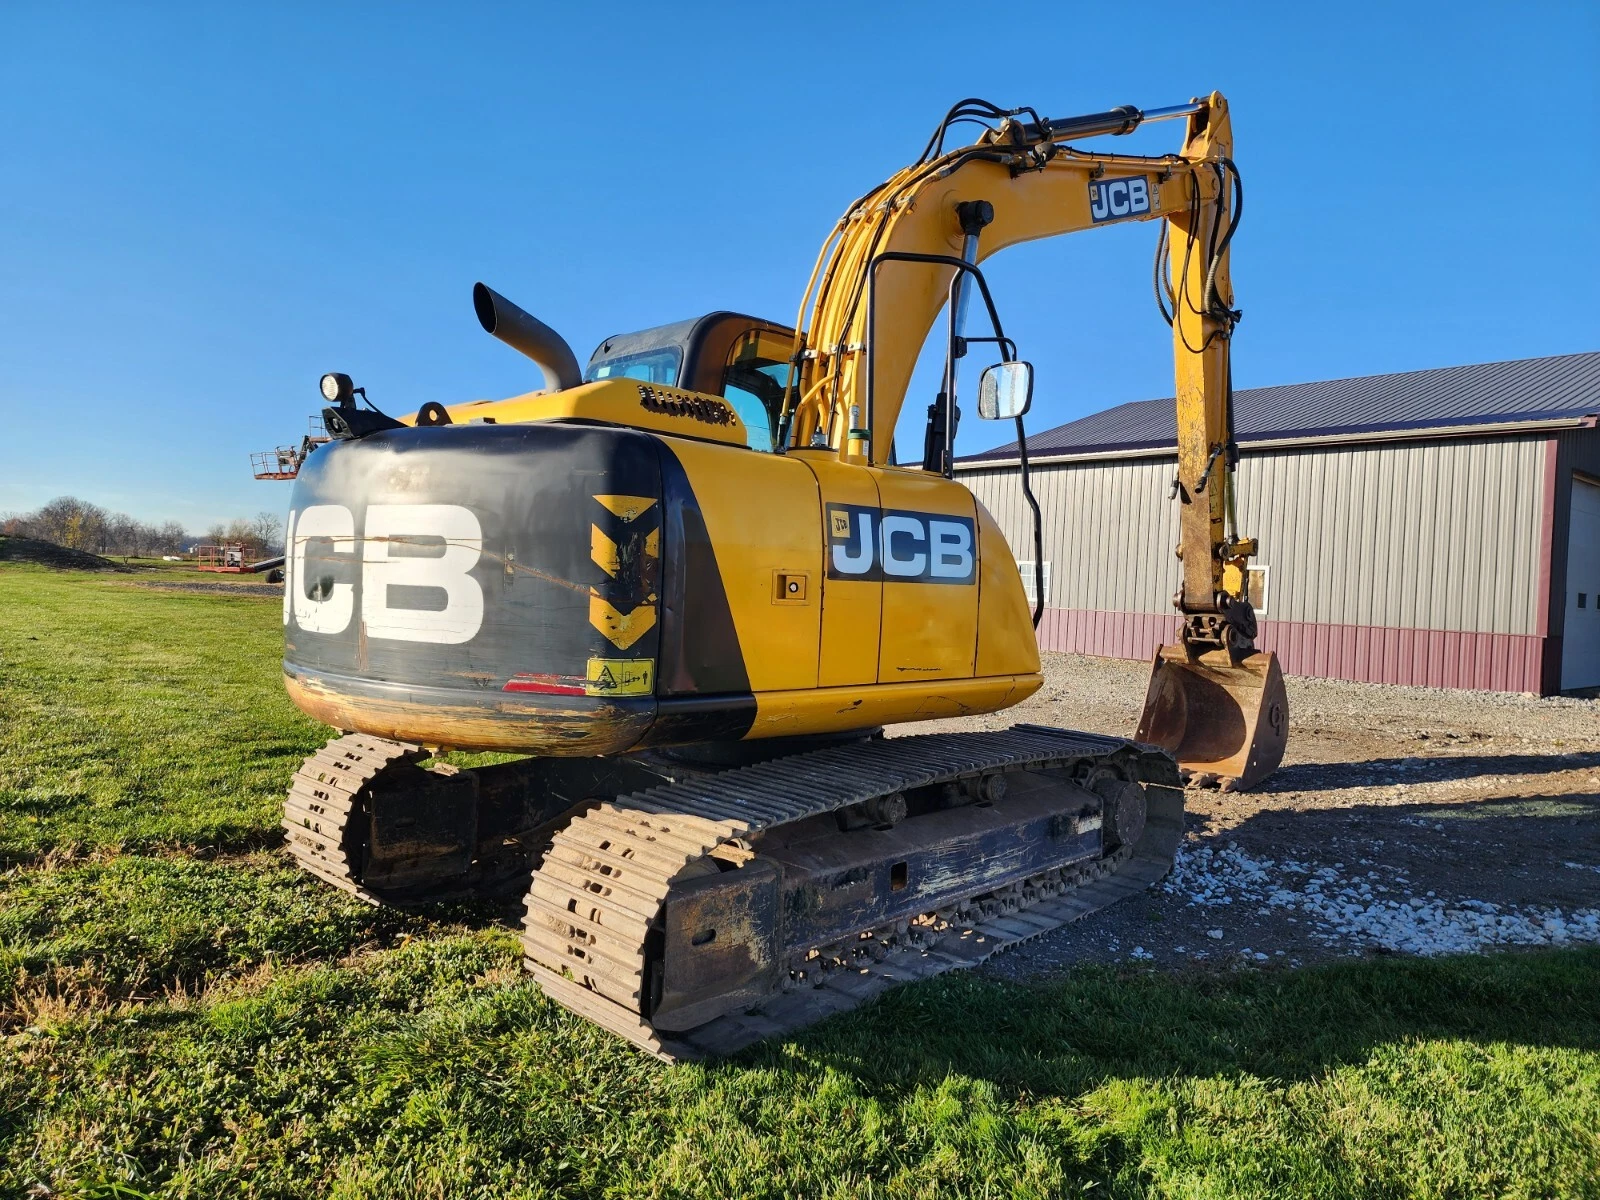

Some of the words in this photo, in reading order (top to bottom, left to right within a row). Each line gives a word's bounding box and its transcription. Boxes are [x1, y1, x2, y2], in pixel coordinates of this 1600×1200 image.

[1092, 179, 1149, 219] JCB
[833, 513, 973, 578] JCB
[835, 517, 848, 531] JCB
[283, 504, 484, 644] CB
